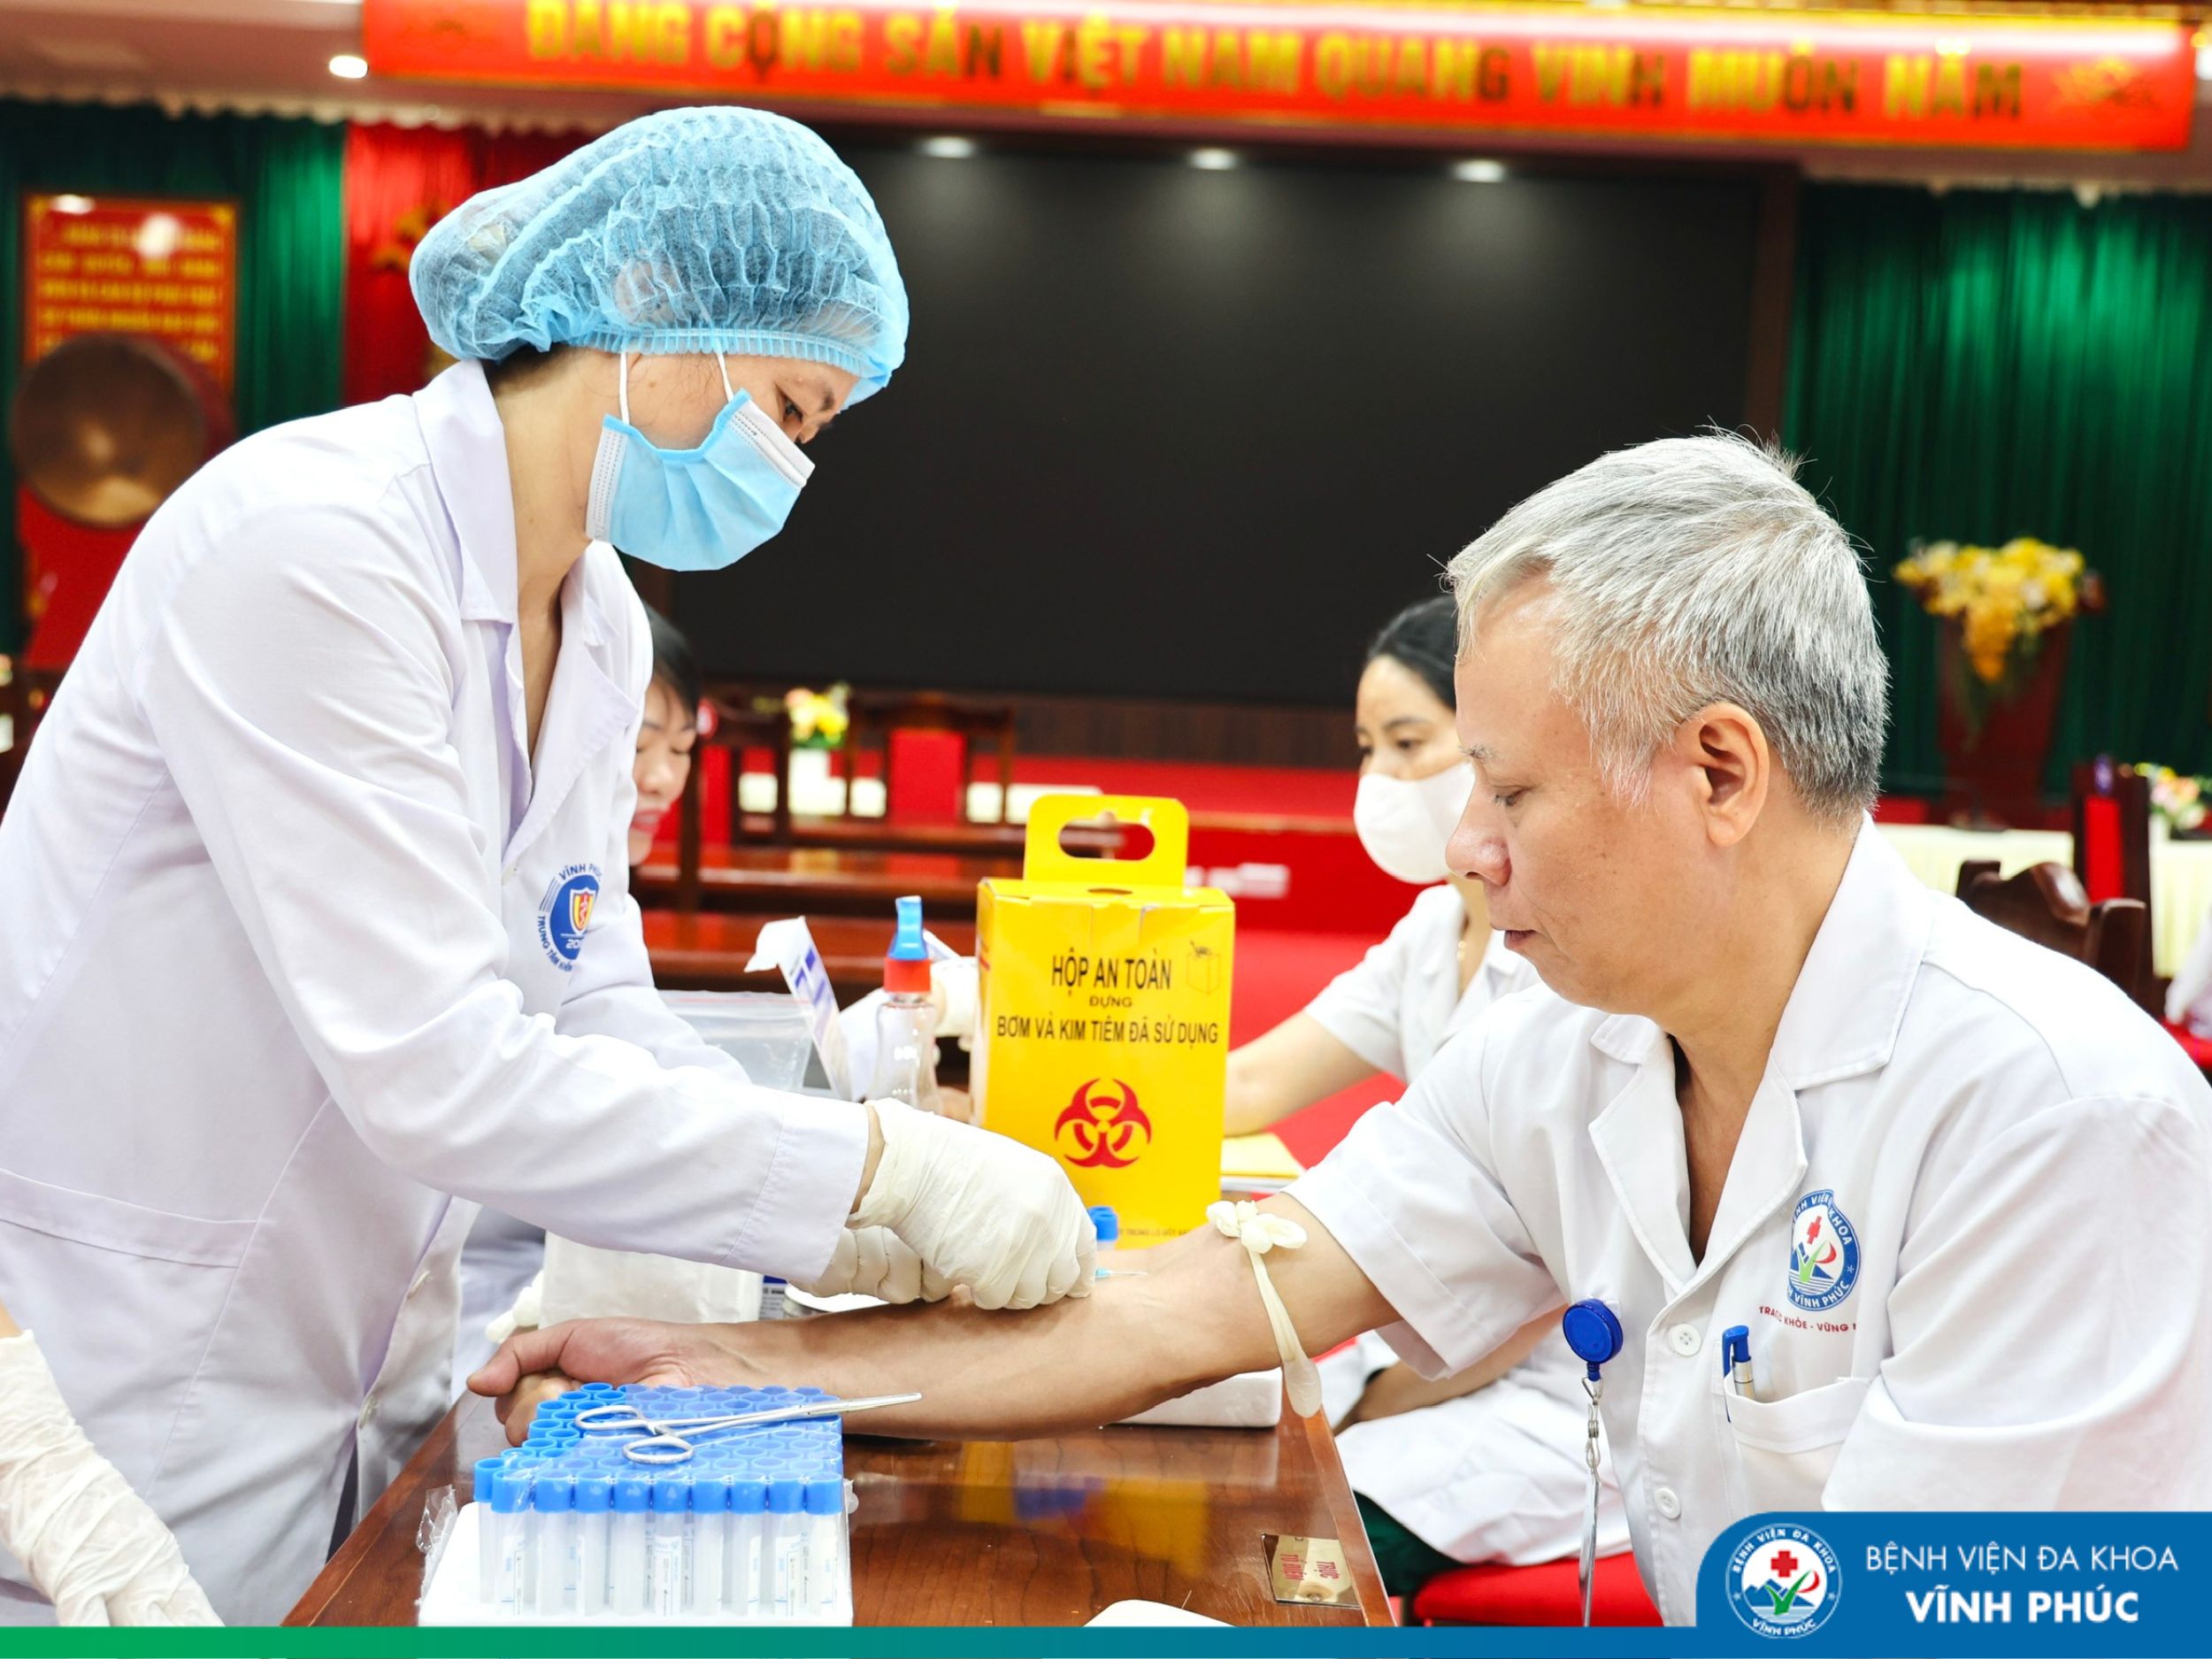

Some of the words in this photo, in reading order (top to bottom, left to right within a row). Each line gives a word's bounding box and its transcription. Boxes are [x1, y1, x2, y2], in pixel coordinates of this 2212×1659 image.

[1021, 8, 1146, 98] VIỆT
[1163, 26, 1301, 95] NAM
[1315, 32, 1510, 102] QUANG
[1531, 39, 1664, 108] VINH
[1688, 38, 1857, 115] MUÔN
[1885, 37, 2021, 119] NĂM
[538, 916, 550, 949] TRUNG
[1051, 947, 1089, 996] HỘP
[1094, 957, 1119, 988] AN
[1125, 949, 1171, 989] TOÀN
[1089, 995, 1133, 1009] ĐỰNG
[997, 1015, 1031, 1037] BƠM
[1035, 1011, 1055, 1039] VÀ
[1059, 1018, 1086, 1041] KIM
[1091, 1015, 1125, 1041] TIÊM
[1128, 1017, 1149, 1042] ĐÃ
[1154, 1014, 1174, 1043] SỬ
[1178, 1022, 1218, 1049] DỤNG
[1794, 1293, 1820, 1308] VĨNH
[1821, 1280, 1849, 1306] PHÚC
[1759, 1306, 1775, 1317] TRA
[1784, 1317, 1808, 1329] KHỎE
[1816, 1322, 1849, 1333] VỮNG
